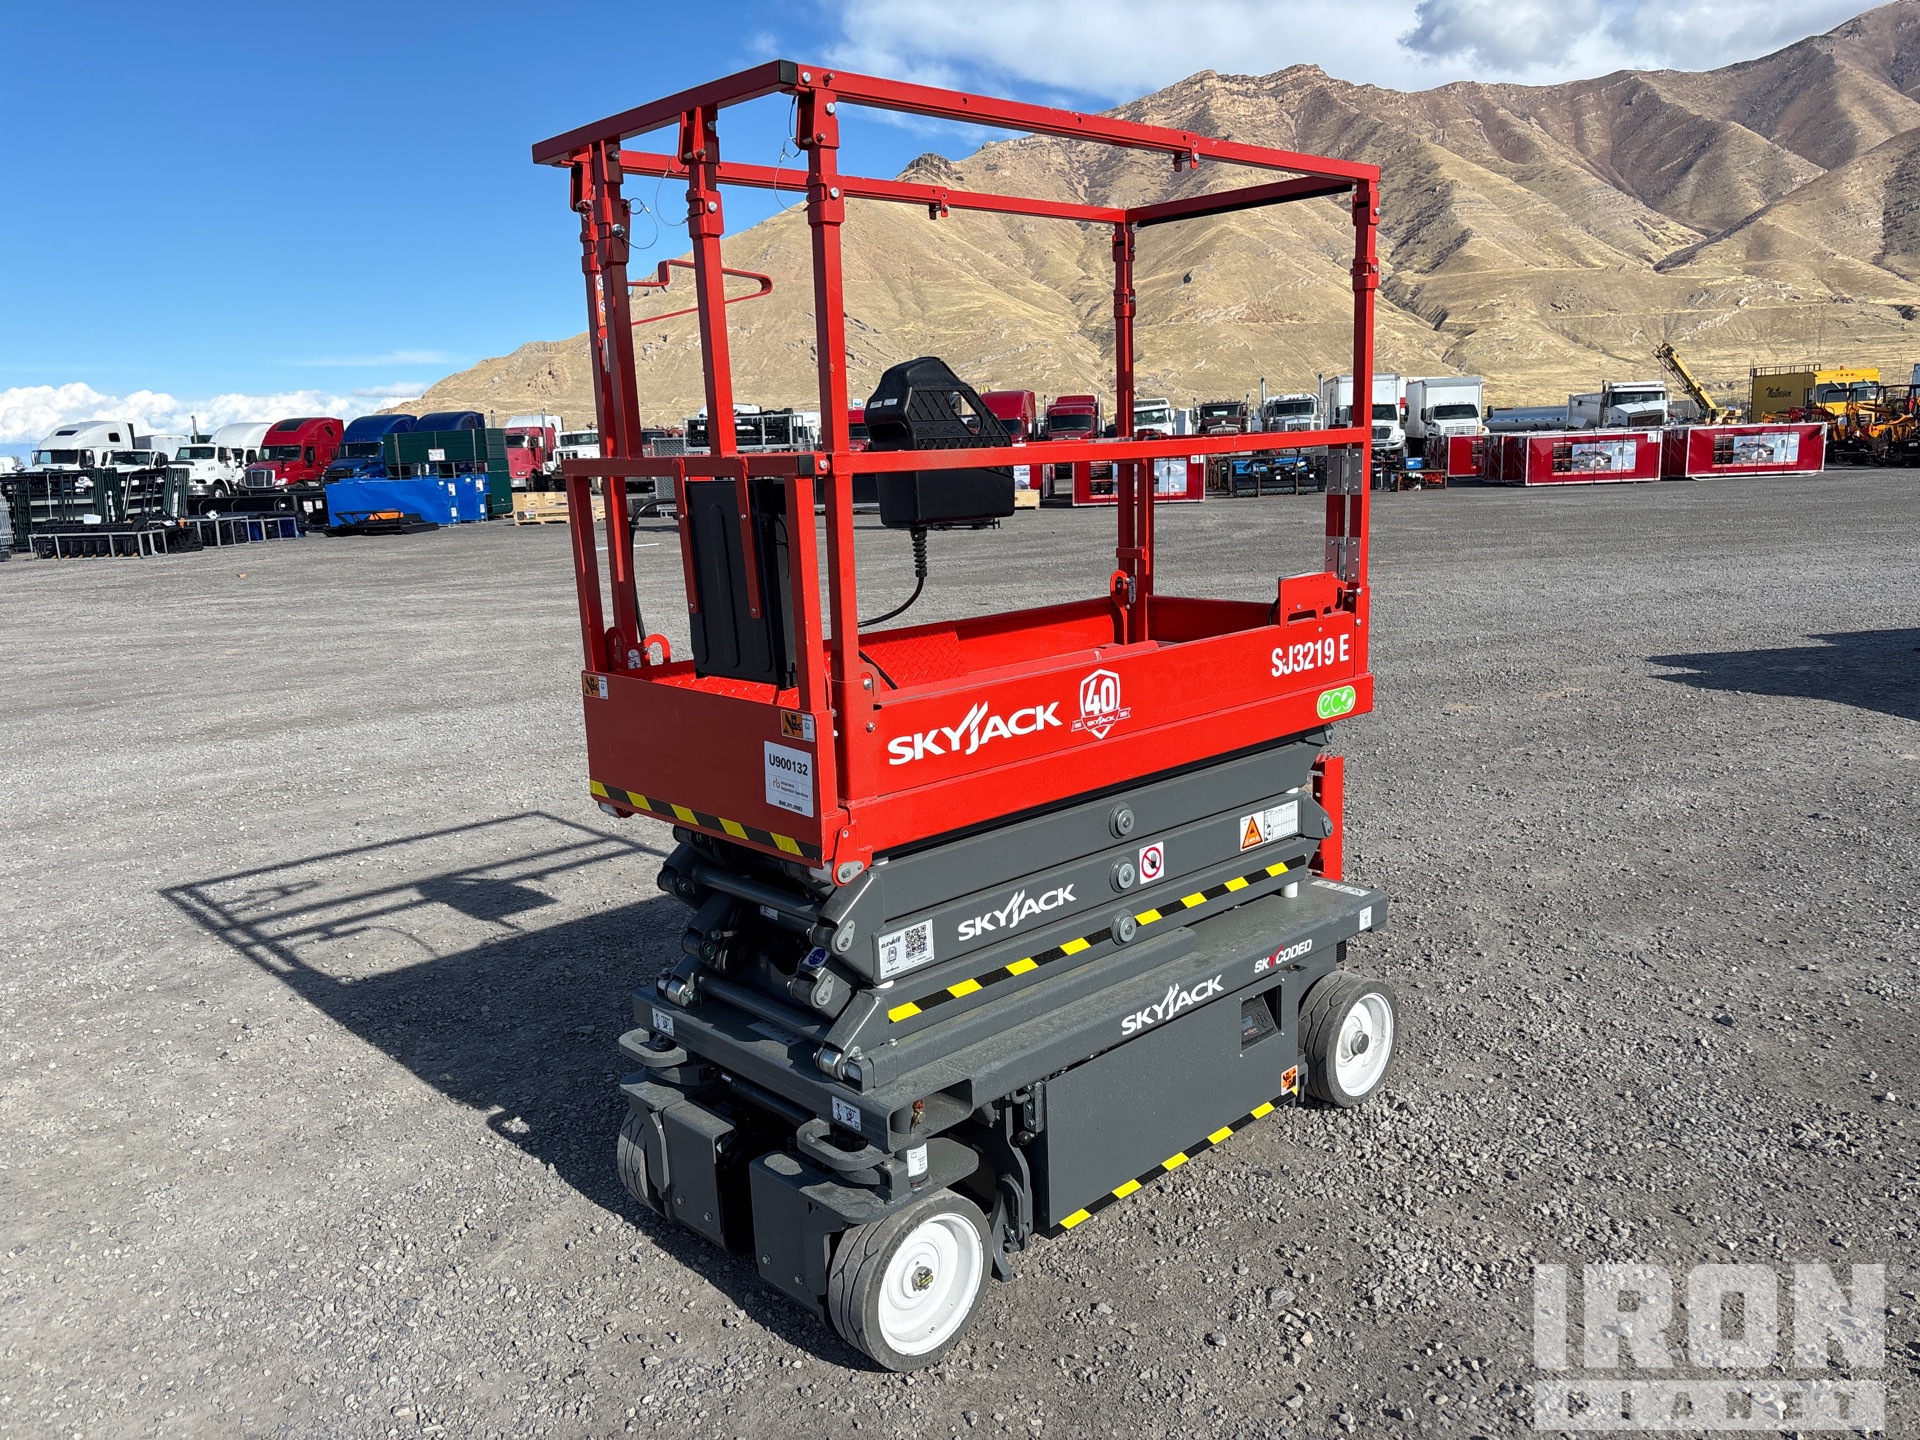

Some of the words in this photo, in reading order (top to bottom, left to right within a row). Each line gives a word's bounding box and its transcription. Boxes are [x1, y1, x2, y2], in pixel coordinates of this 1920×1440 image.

[1271, 637, 1335, 677] SJ3219
[1339, 633, 1349, 662] E
[1085, 677, 1115, 716] 40
[888, 700, 1063, 765] SKYJACK
[769, 753, 808, 776] U900132
[957, 883, 1077, 942] SKYJACK
[1254, 938, 1312, 974] SKYCODED
[1121, 974, 1225, 1036] SKYJACK
